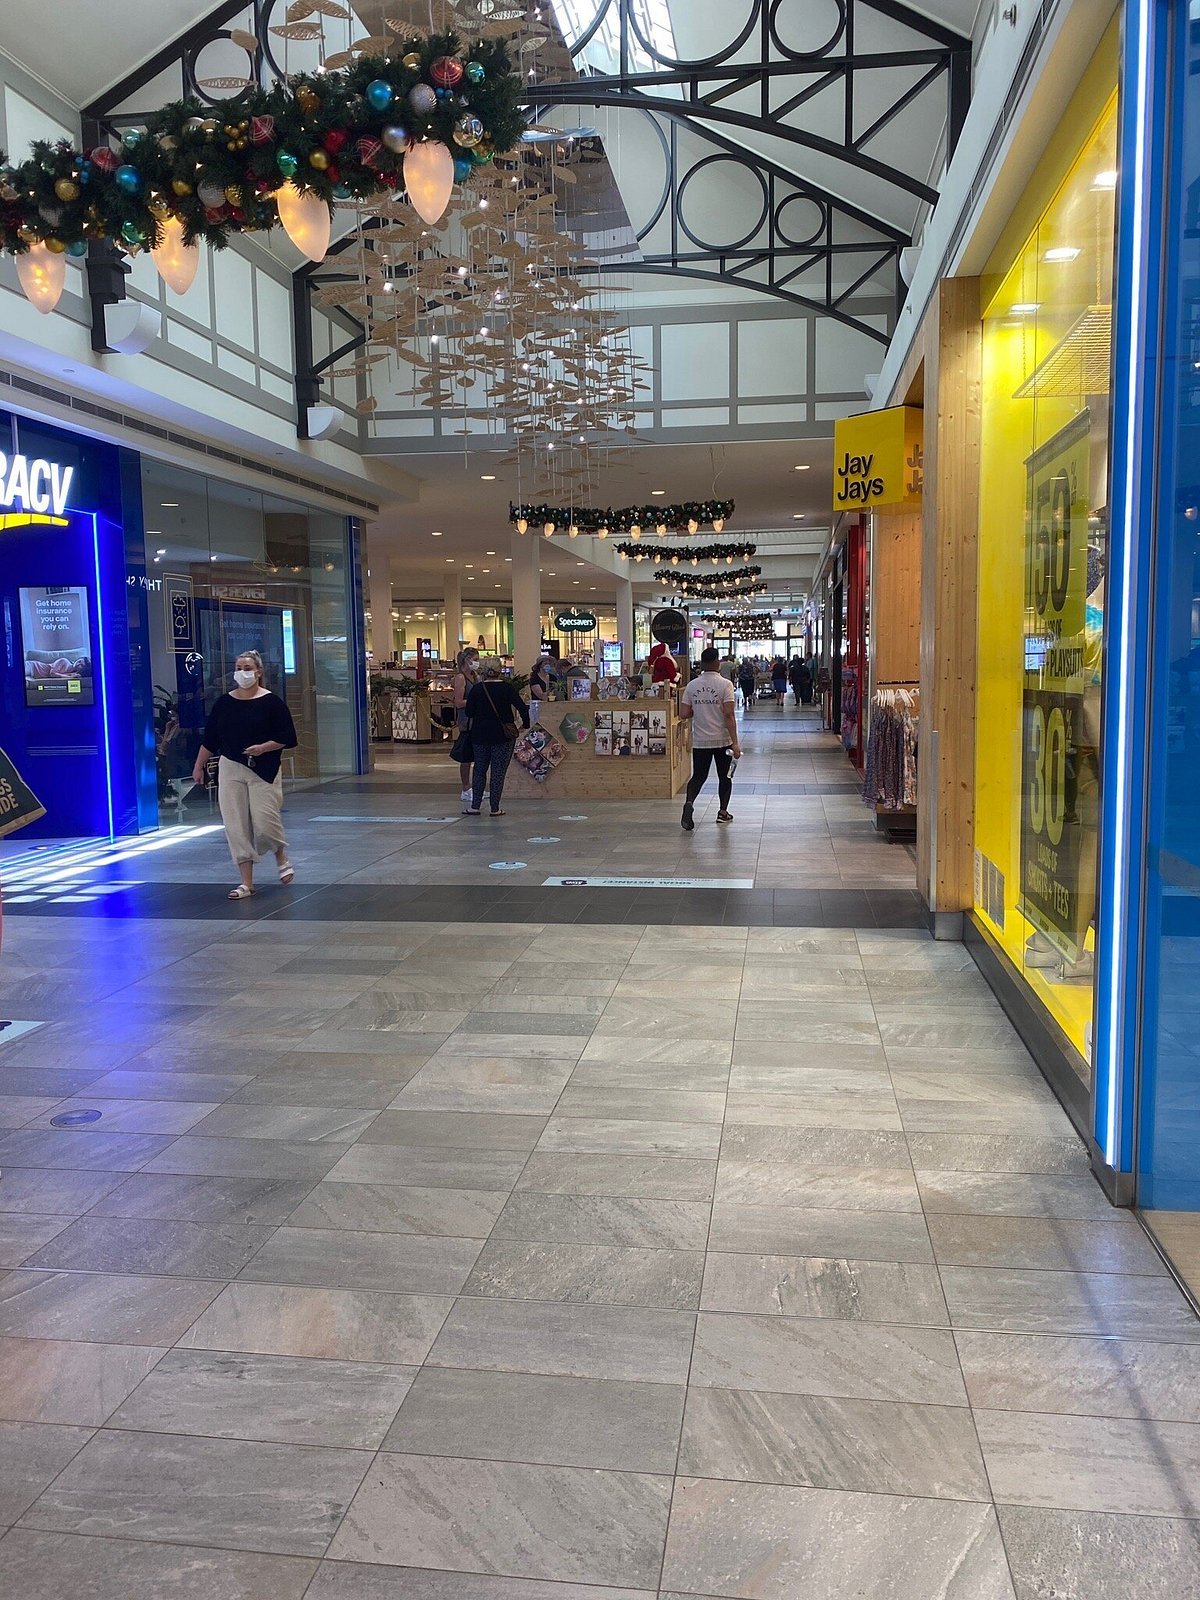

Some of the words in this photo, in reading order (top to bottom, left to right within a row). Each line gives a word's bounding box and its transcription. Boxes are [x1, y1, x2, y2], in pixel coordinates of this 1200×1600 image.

[838, 453, 873, 477] Jay
[838, 478, 884, 503] Jays
[36, 607, 73, 615] insurance
[40, 616, 54, 624] you
[558, 617, 594, 627] Specsavers
[42, 623, 57, 631] rely
[1050, 647, 1083, 678] PLAYSUITS
[1031, 705, 1066, 845] 30
[1053, 880, 1069, 919] TEES
